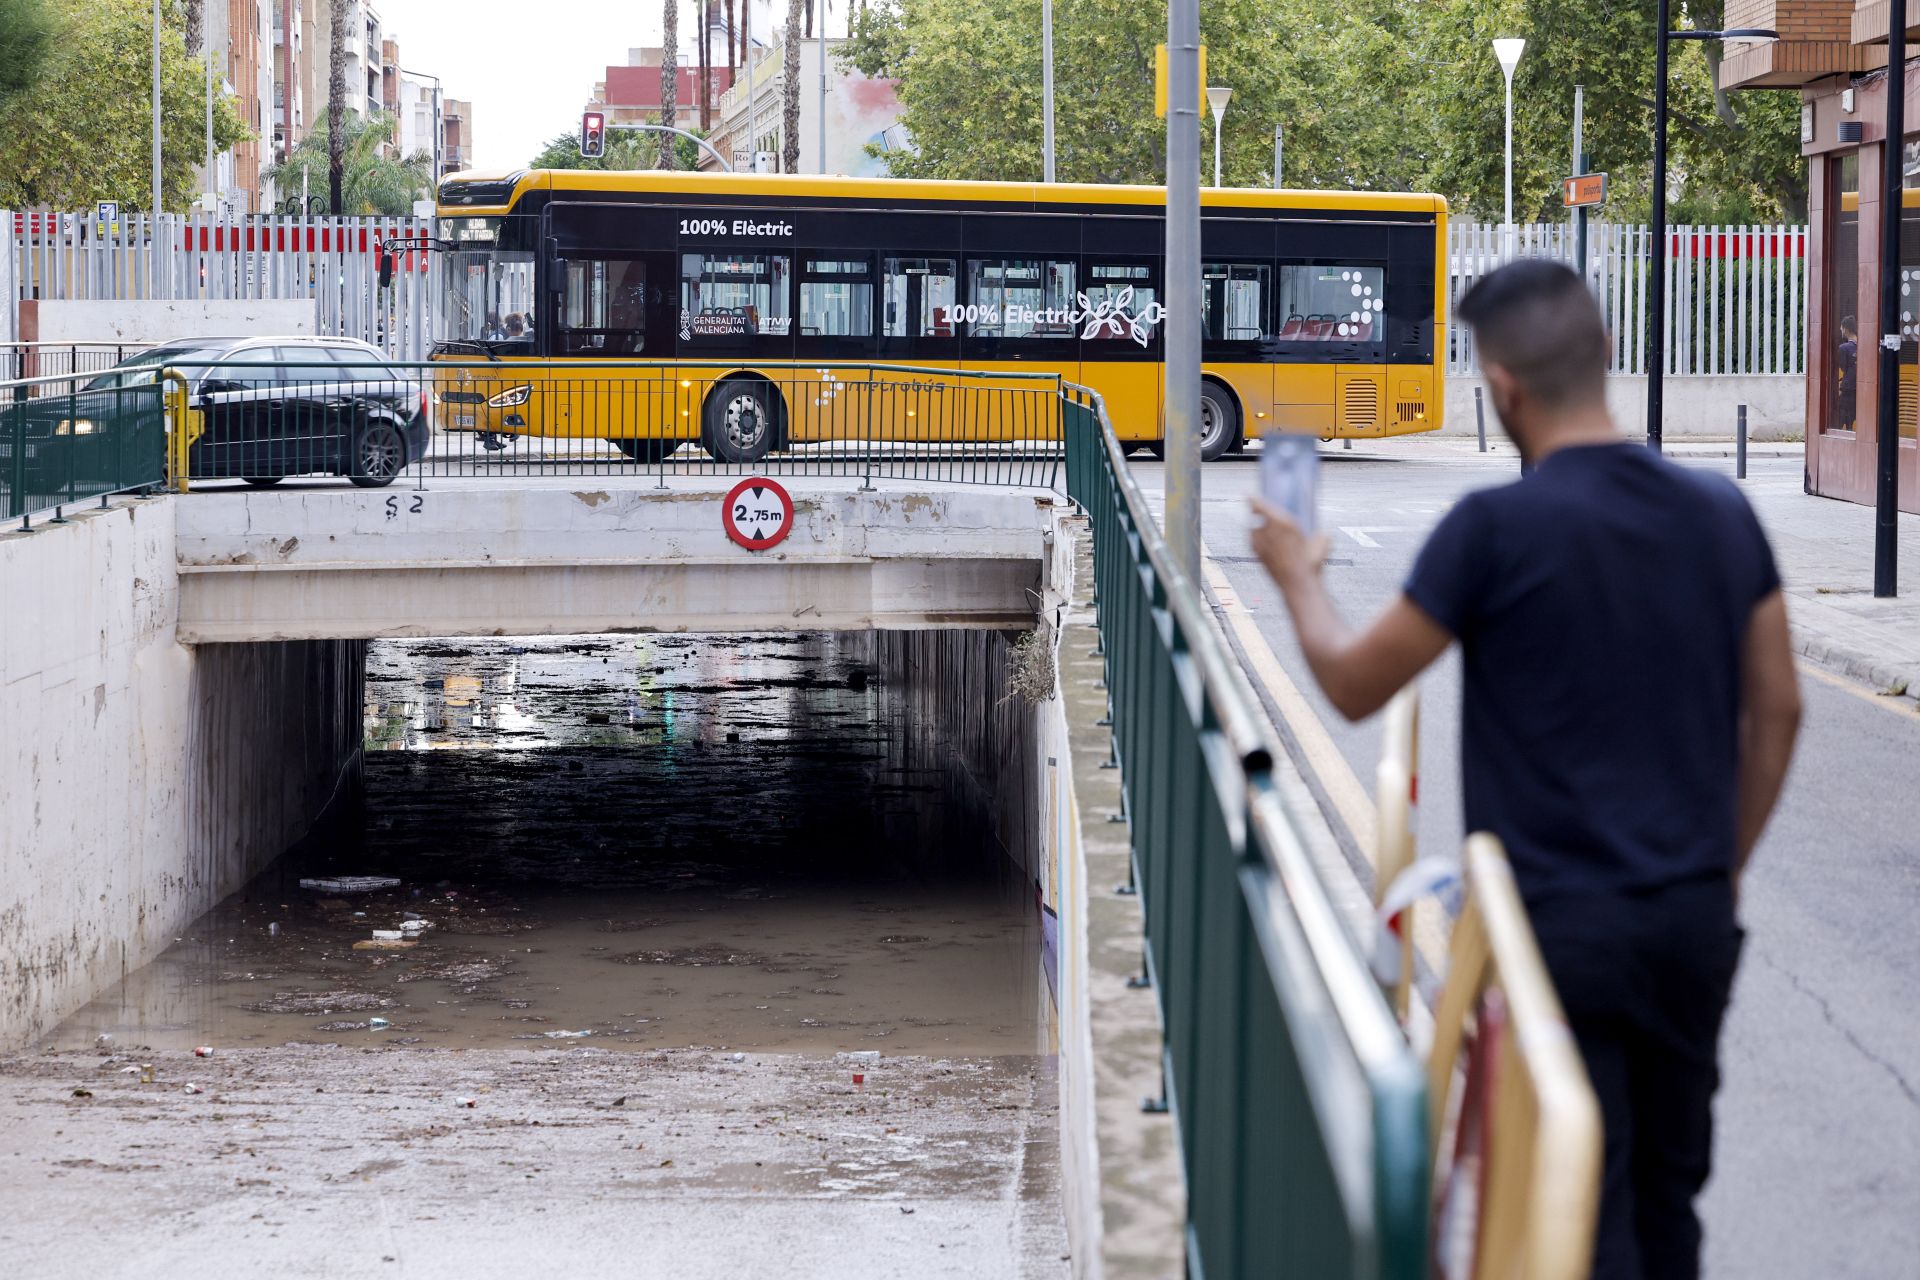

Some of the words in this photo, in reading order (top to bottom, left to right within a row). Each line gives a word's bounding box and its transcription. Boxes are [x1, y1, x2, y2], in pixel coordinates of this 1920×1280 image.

[439, 219, 454, 241] 162
[680, 219, 727, 235] 100%
[732, 219, 793, 236] Elèctric
[693, 316, 746, 325] GENERALITAT
[941, 304, 999, 324] 100%
[1005, 303, 1080, 324] Elèctric
[693, 326, 745, 334] VALENCIANA
